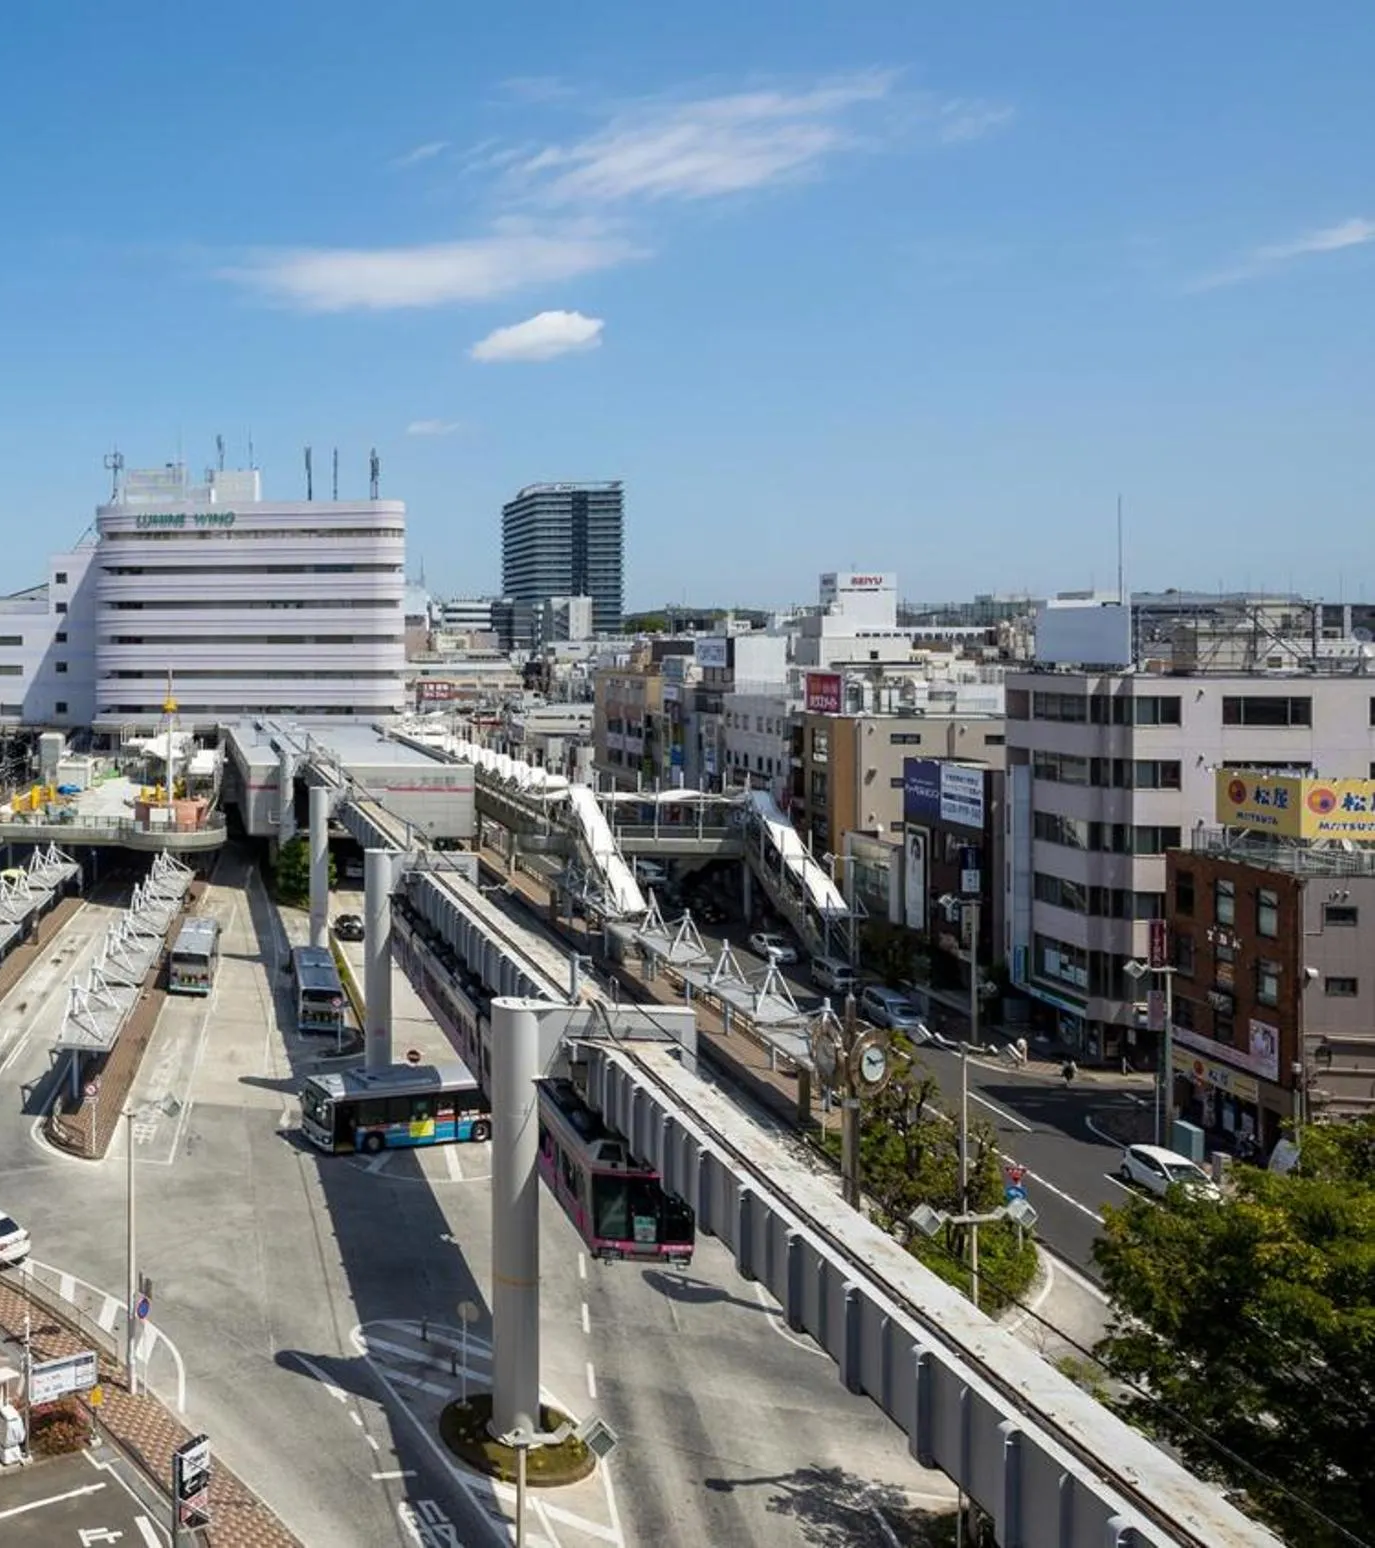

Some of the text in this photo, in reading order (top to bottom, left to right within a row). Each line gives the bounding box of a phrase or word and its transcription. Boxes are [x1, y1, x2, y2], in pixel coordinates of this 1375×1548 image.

[136, 510, 236, 529] LUMINE WING
[1253, 784, 1289, 809] 松屋
[1340, 791, 1375, 812] 松
